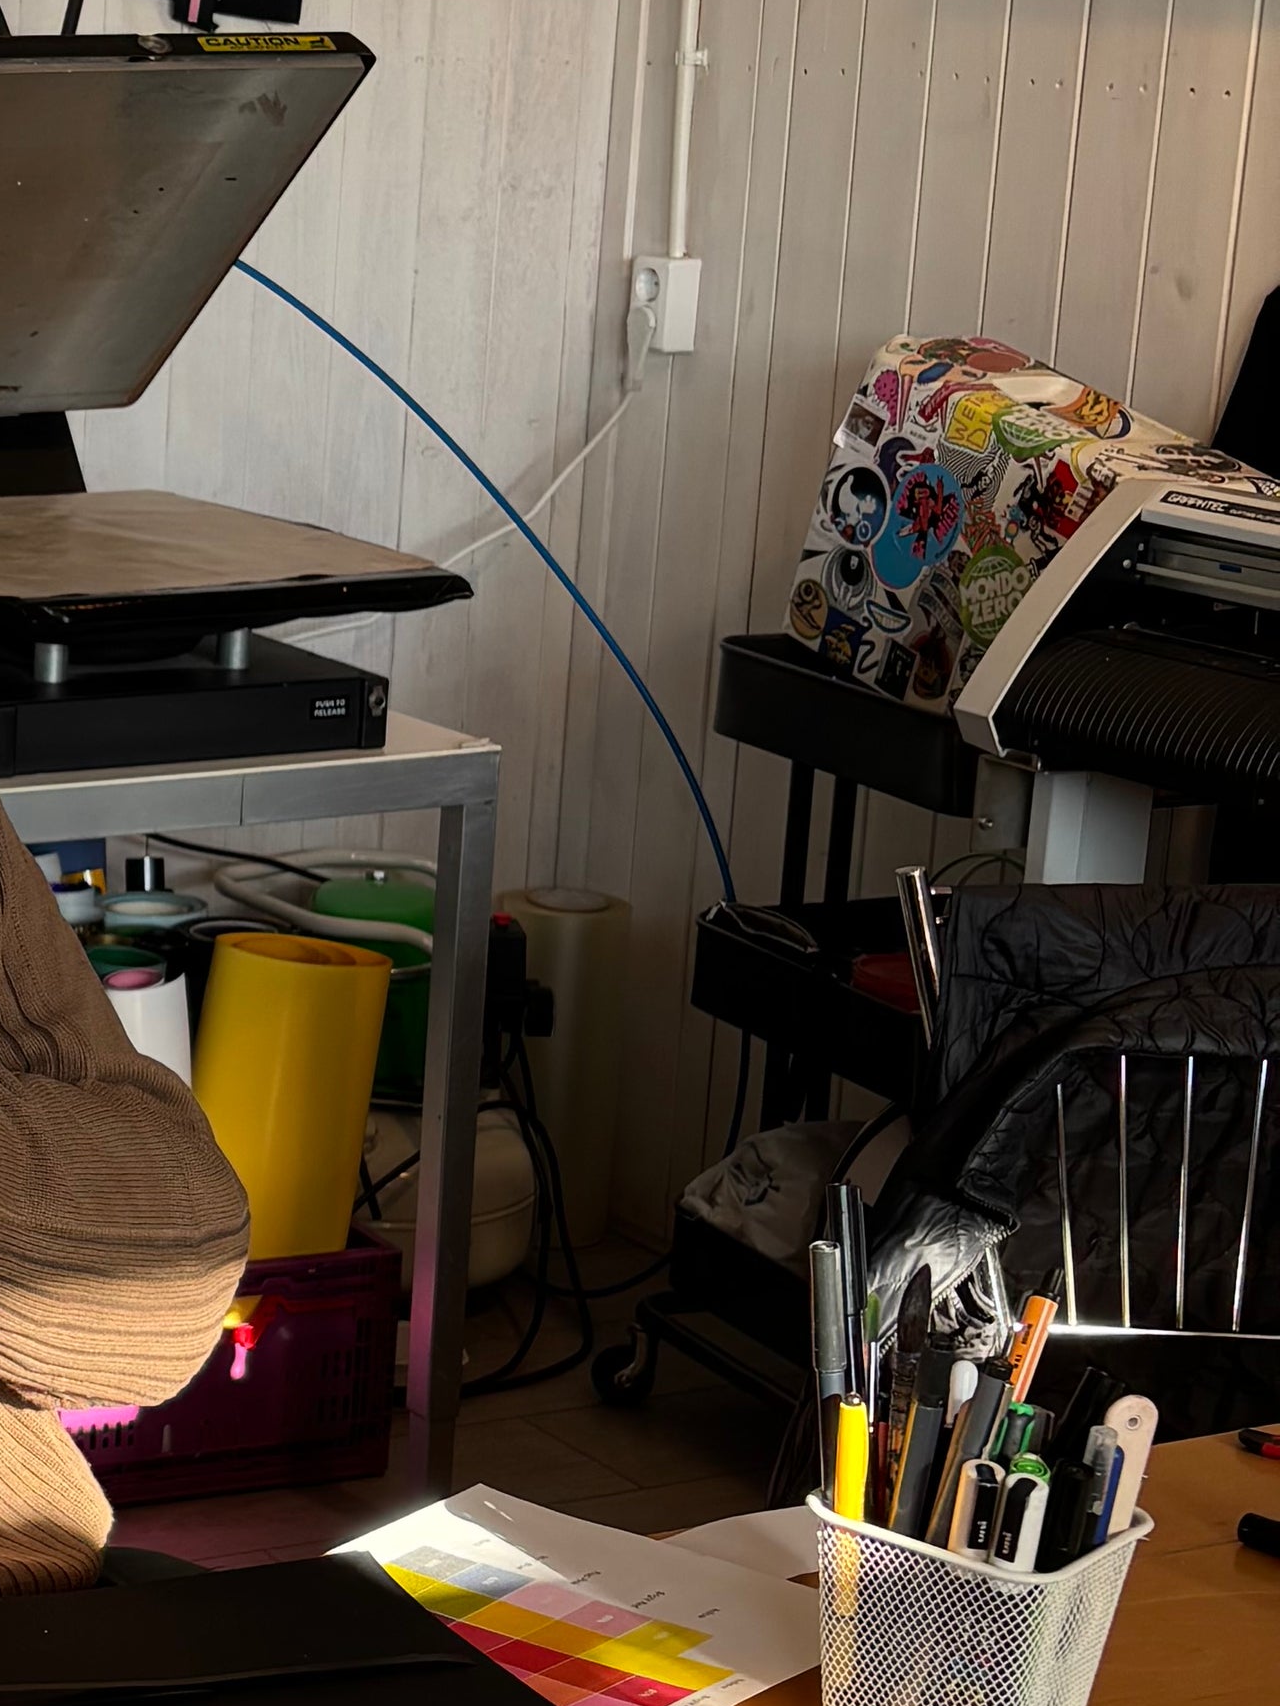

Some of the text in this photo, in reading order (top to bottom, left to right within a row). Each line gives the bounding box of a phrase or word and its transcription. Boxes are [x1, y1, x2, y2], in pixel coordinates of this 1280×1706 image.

[205, 37, 301, 47] CAUTION
[1167, 493, 1229, 512] GRAPHTEC
[959, 566, 1030, 608] MONDO
[969, 591, 1023, 625] ZERO
[976, 1520, 988, 1543] uni
[1002, 1531, 1012, 1554] uni
